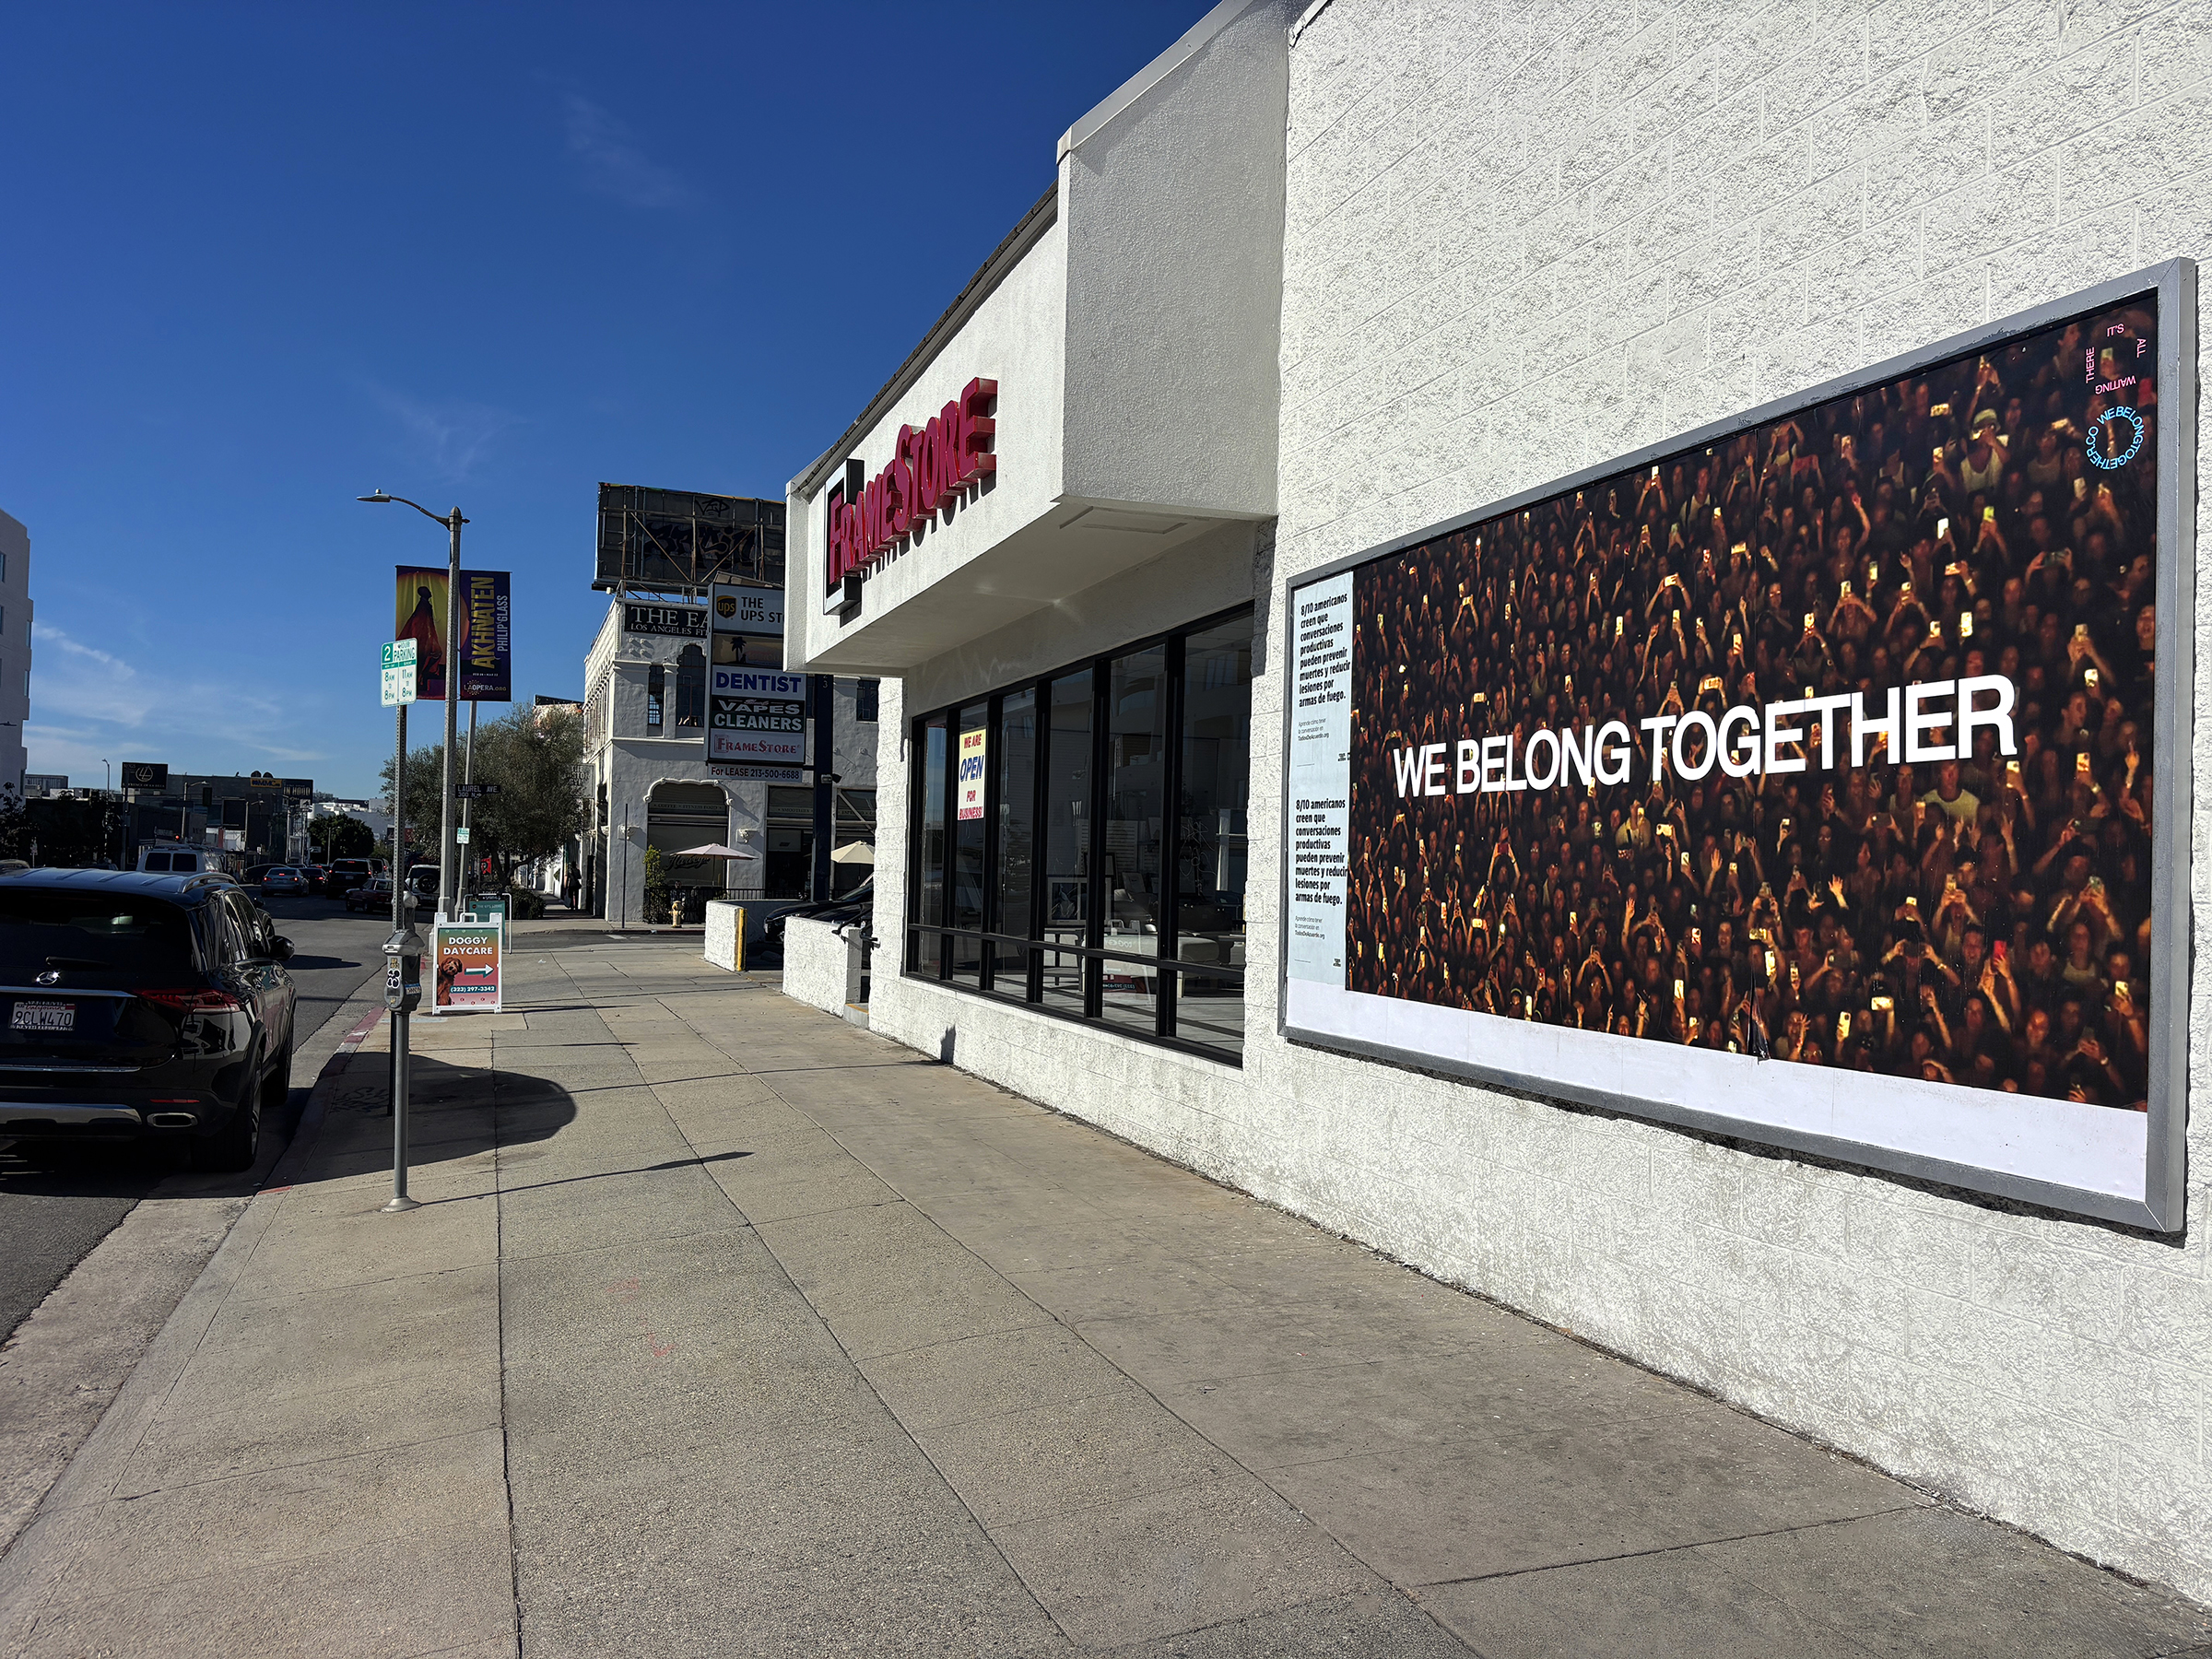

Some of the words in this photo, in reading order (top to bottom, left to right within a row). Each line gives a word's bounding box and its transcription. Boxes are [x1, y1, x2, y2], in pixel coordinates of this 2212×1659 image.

[2107, 324, 2124, 337] IT'S
[2136, 338, 2147, 358] ALL
[2086, 347, 2095, 383] THERE
[2095, 375, 2136, 394] WAITING
[497, 594, 508, 622] GLASS
[718, 602, 735, 616] ups
[741, 597, 764, 608] THE
[1300, 602, 1313, 617] 8/10
[1314, 594, 1347, 611] americanos
[630, 606, 679, 627] THE
[740, 609, 764, 621] UPS
[1300, 617, 1316, 629] creen
[1317, 613, 1328, 626] que
[471, 577, 495, 668] AKHNATEN
[631, 622, 648, 631] LOS
[651, 625, 692, 635] ANGELES
[497, 623, 508, 652] PHILIP
[1300, 622, 1344, 642] conversaciones
[384, 646, 391, 661] 2
[394, 647, 415, 661] PARKING
[1300, 639, 1334, 657] productivas
[1300, 654, 1322, 670] pueden
[1323, 647, 1347, 665] prevenir
[384, 672, 394, 682] 8AM
[402, 669, 413, 679] 11AM
[1300, 668, 1324, 681] muertes
[1324, 667, 1328, 677] y
[1330, 660, 1350, 675] reducir
[716, 672, 801, 693] DENTIST
[1299, 682, 1323, 694] lesiones
[1324, 679, 1334, 691] por
[384, 689, 394, 700] 8PM
[402, 688, 412, 698] 8PM
[1299, 696, 1317, 707] armas
[1318, 693, 1325, 703] de
[1327, 690, 1346, 702] fuego.
[718, 700, 800, 715] VAPES
[714, 713, 802, 731] CLEANERS
[964, 736, 971, 748] WE
[971, 734, 982, 747] ARE
[1393, 742, 1447, 798] WE
[1455, 721, 1630, 794] BELONG
[1639, 674, 2018, 782] TOGETHER
[712, 767, 724, 776] For
[725, 768, 748, 777] LEASE
[960, 755, 984, 782] OPEN
[967, 790, 976, 803] FOR
[1296, 799, 1310, 812] 8/10
[1311, 798, 1346, 809] americanos
[1296, 815, 1312, 823] creen
[1313, 814, 1325, 825] que
[1296, 825, 1341, 836] conversaciones
[1296, 839, 1331, 851] productivas
[1296, 852, 1318, 865] pueden
[1319, 853, 1345, 865] prevenir
[1296, 866, 1320, 876] muertes
[1321, 868, 1325, 878] y
[1326, 865, 1347, 877] reducir
[1296, 877, 1319, 889] lesiones
[1320, 881, 1330, 891] por
[1296, 892, 1313, 902] armas
[1314, 892, 1322, 903] de
[1323, 892, 1342, 906] fuego.
[449, 936, 488, 945] DOGGY
[14, 1011, 72, 1026] 9CLW470
